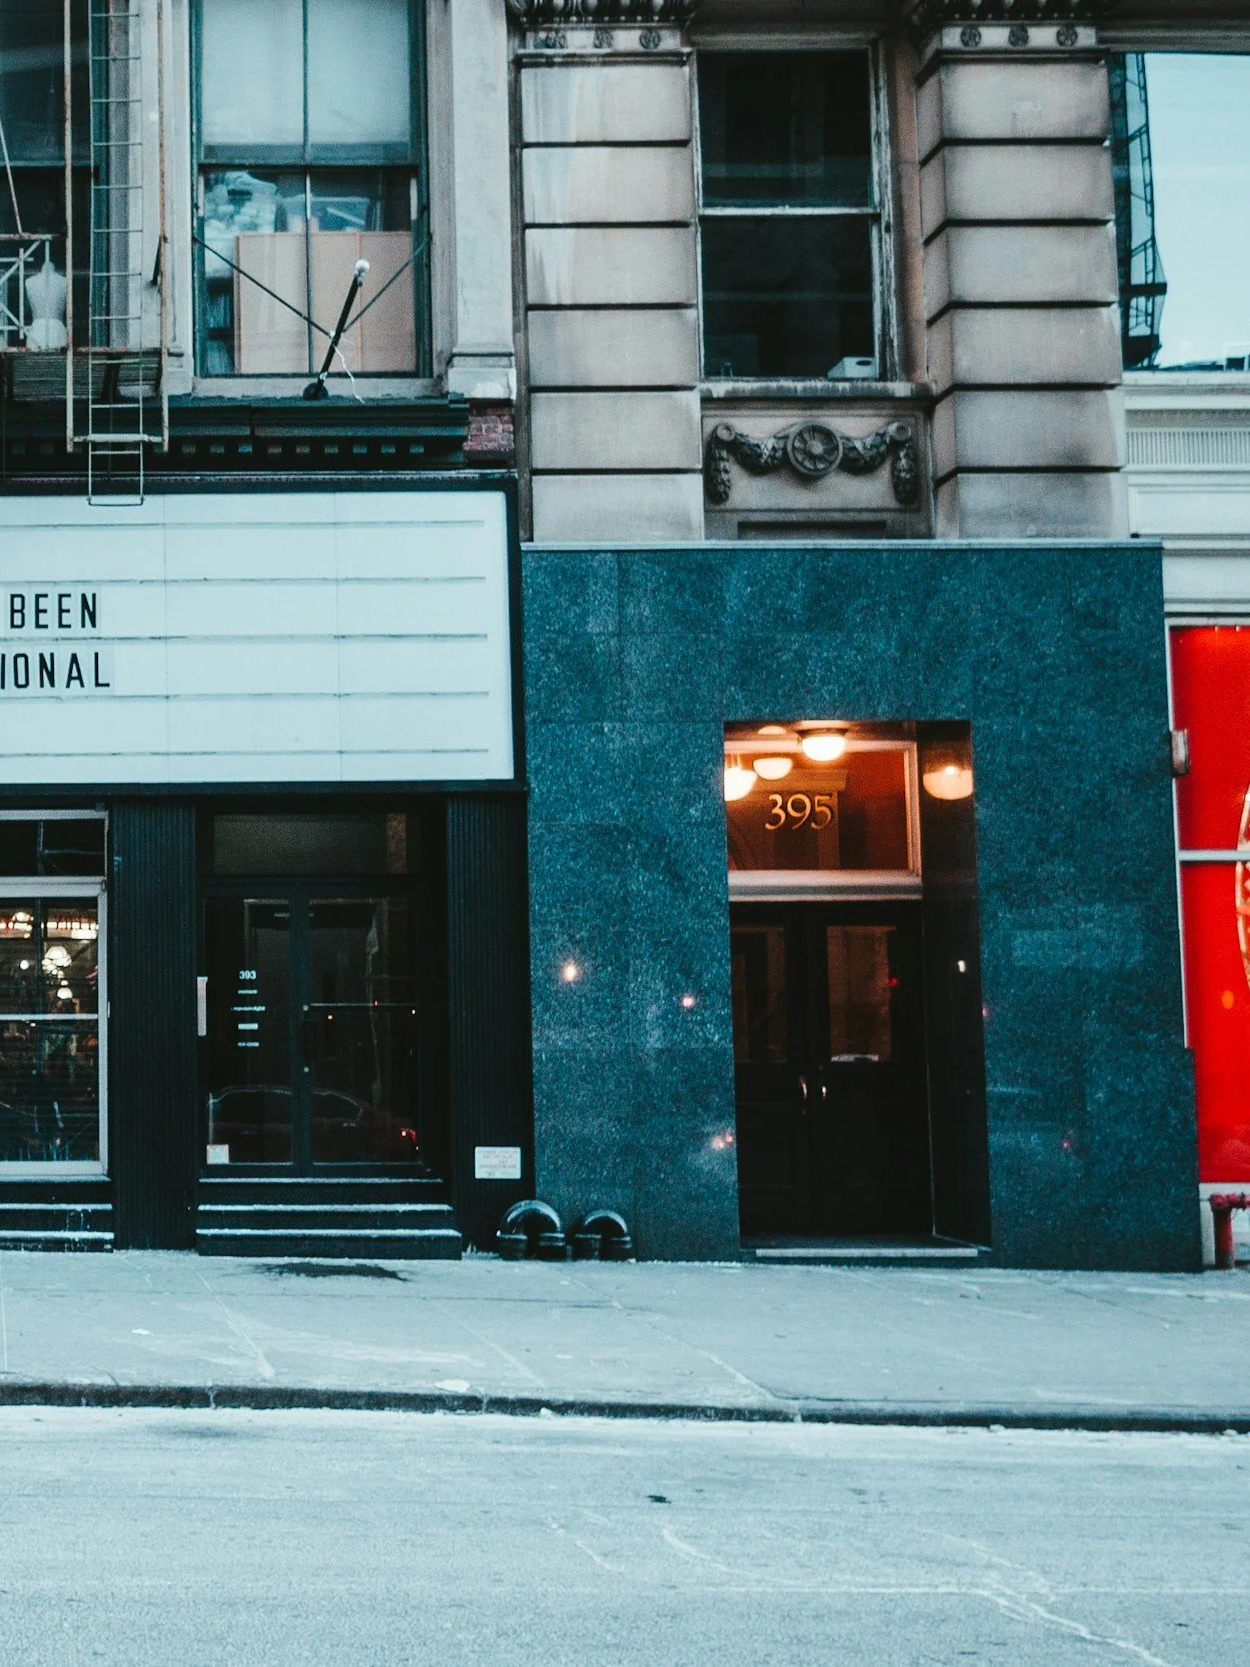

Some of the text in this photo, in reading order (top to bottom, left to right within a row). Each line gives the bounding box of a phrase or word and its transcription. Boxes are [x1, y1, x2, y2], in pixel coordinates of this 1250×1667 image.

[10, 592, 97, 629] BEEN
[764, 793, 835, 830] 395
[239, 970, 257, 980] 393
